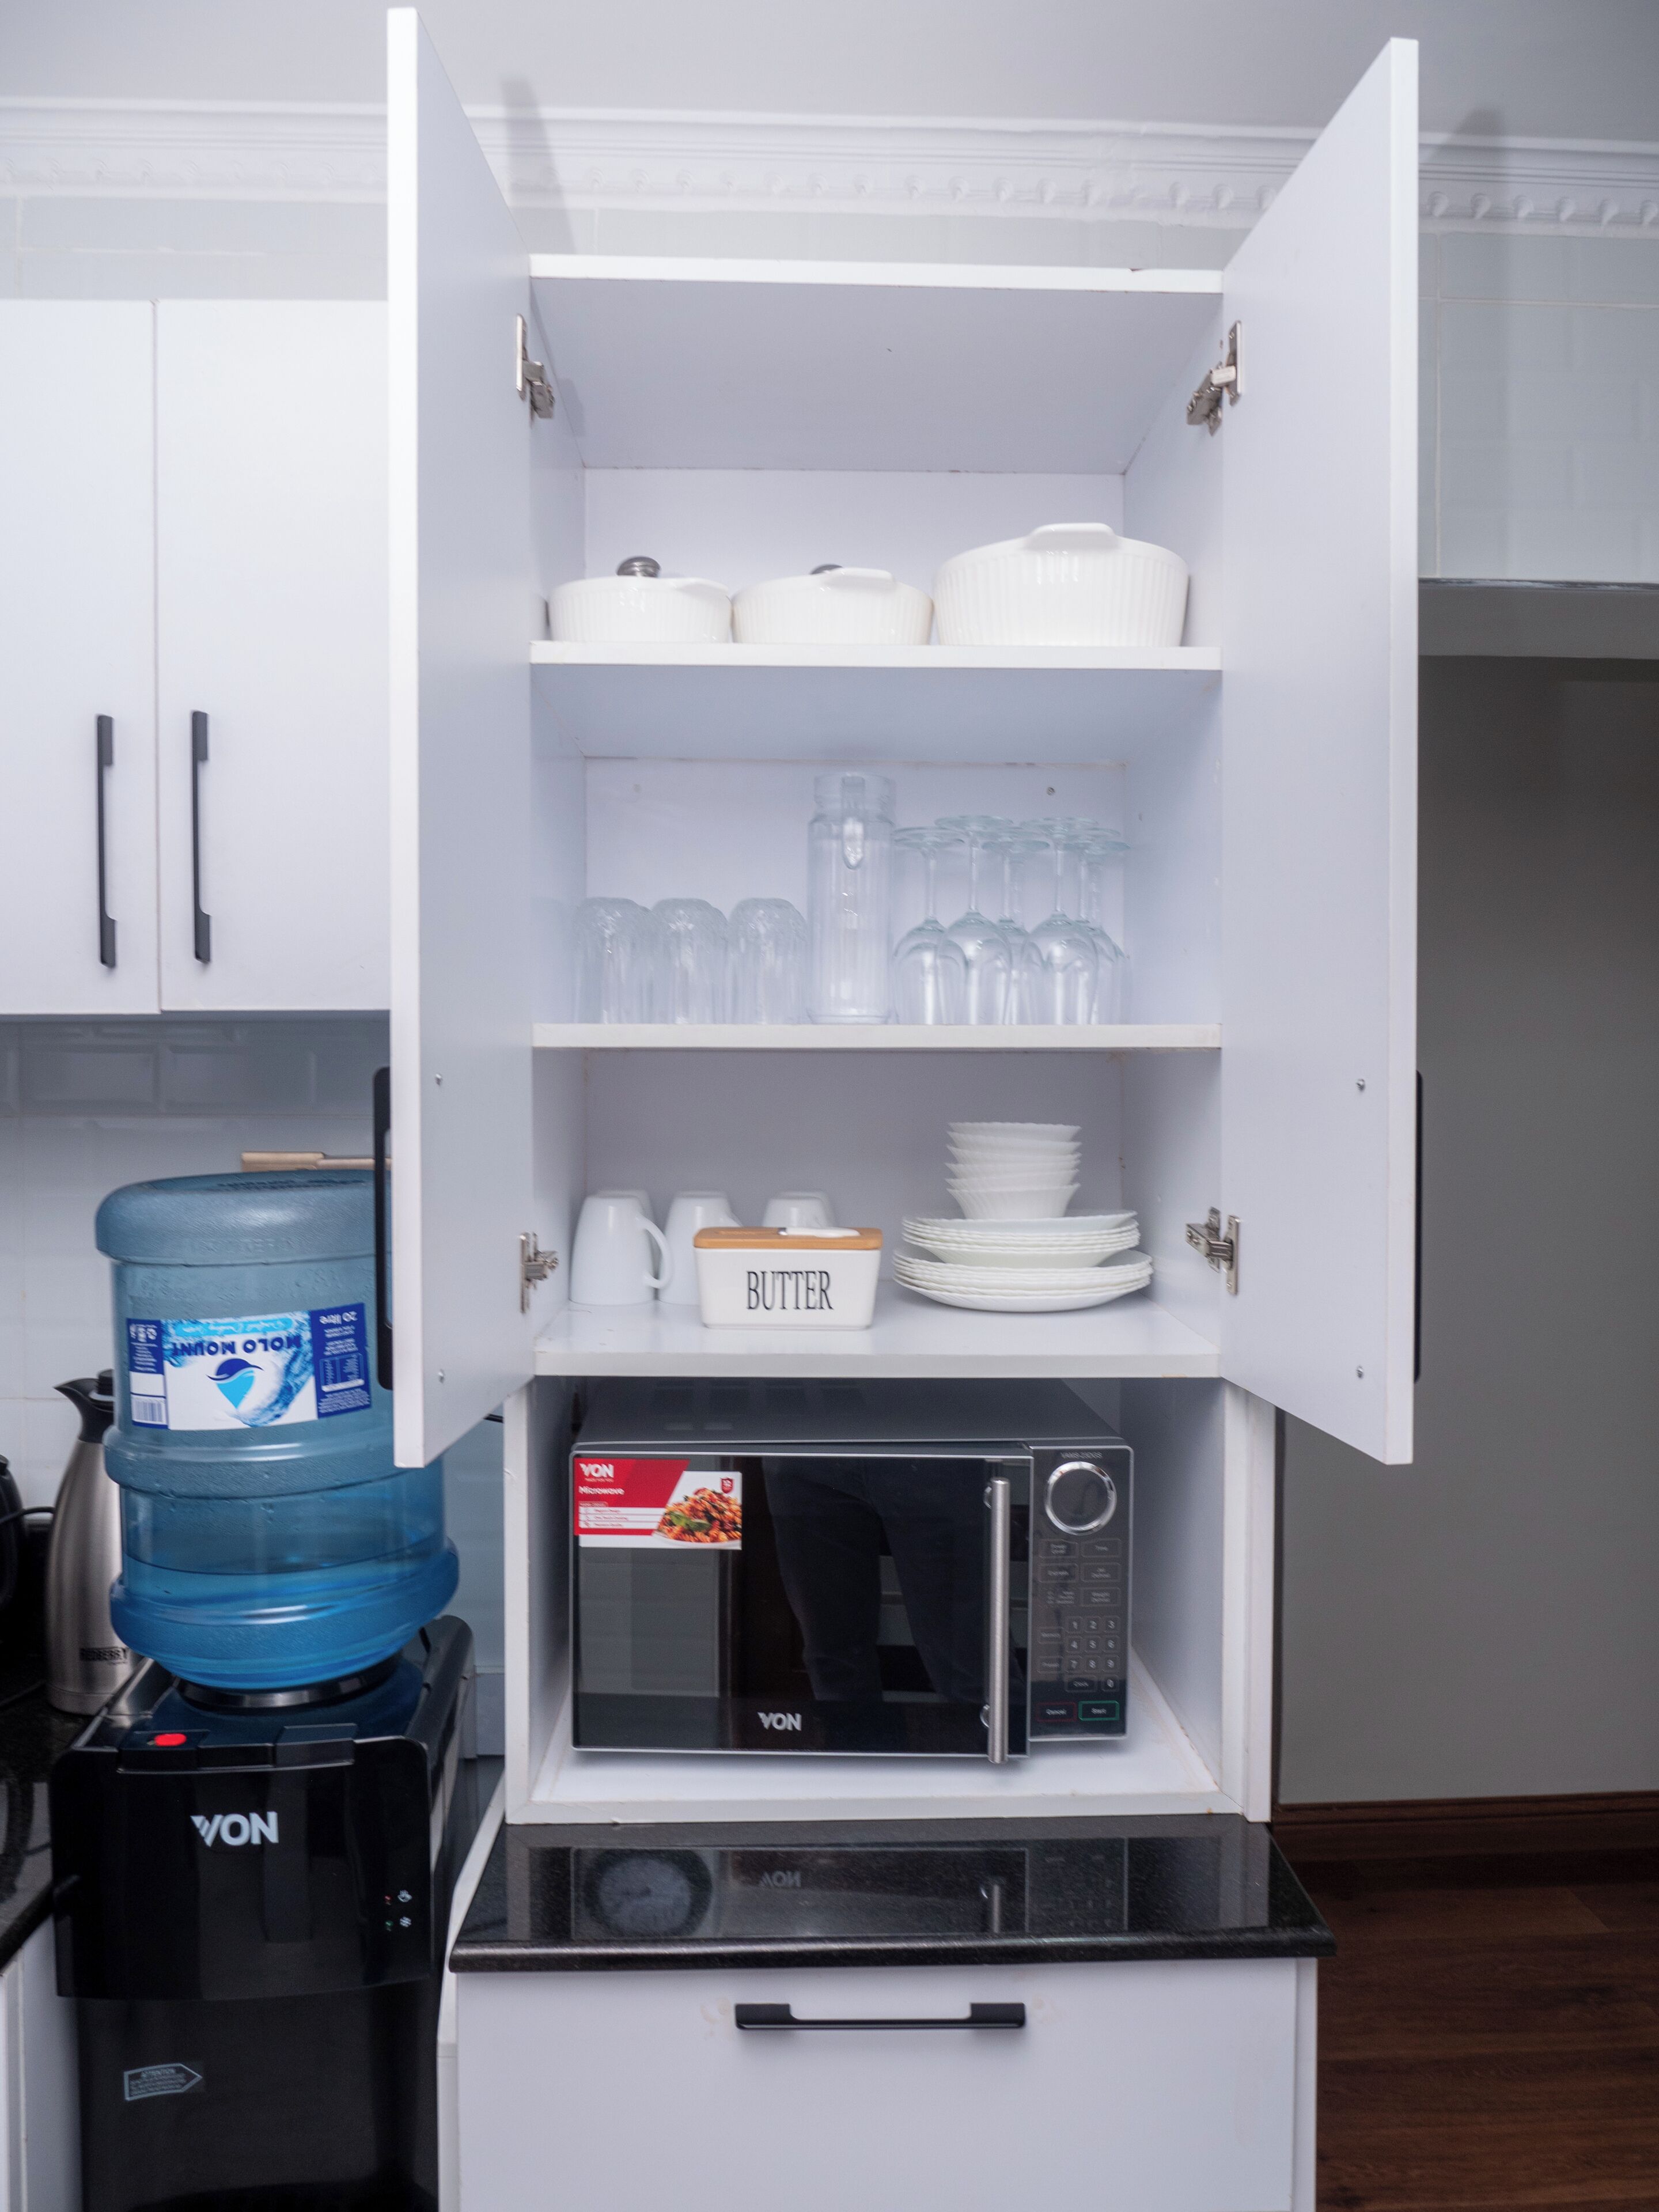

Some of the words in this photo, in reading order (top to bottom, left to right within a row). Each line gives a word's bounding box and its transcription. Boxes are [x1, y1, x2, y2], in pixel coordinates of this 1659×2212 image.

[747, 1271, 834, 1310] BUTTER
[319, 1314, 341, 1325] litre
[342, 1310, 358, 1323] 20
[243, 1335, 301, 1354] MOLO
[579, 1463, 614, 1478] VON
[578, 1485, 625, 1495] Microwave
[1071, 1620, 1078, 1630] 1
[1089, 1620, 1097, 1630] 2
[1108, 1620, 1115, 1630] 3
[1070, 1640, 1078, 1650] 4
[1089, 1640, 1097, 1649] 5
[1107, 1639, 1115, 1649] 6
[756, 1711, 802, 1731] VON
[190, 1811, 279, 1847] VON
